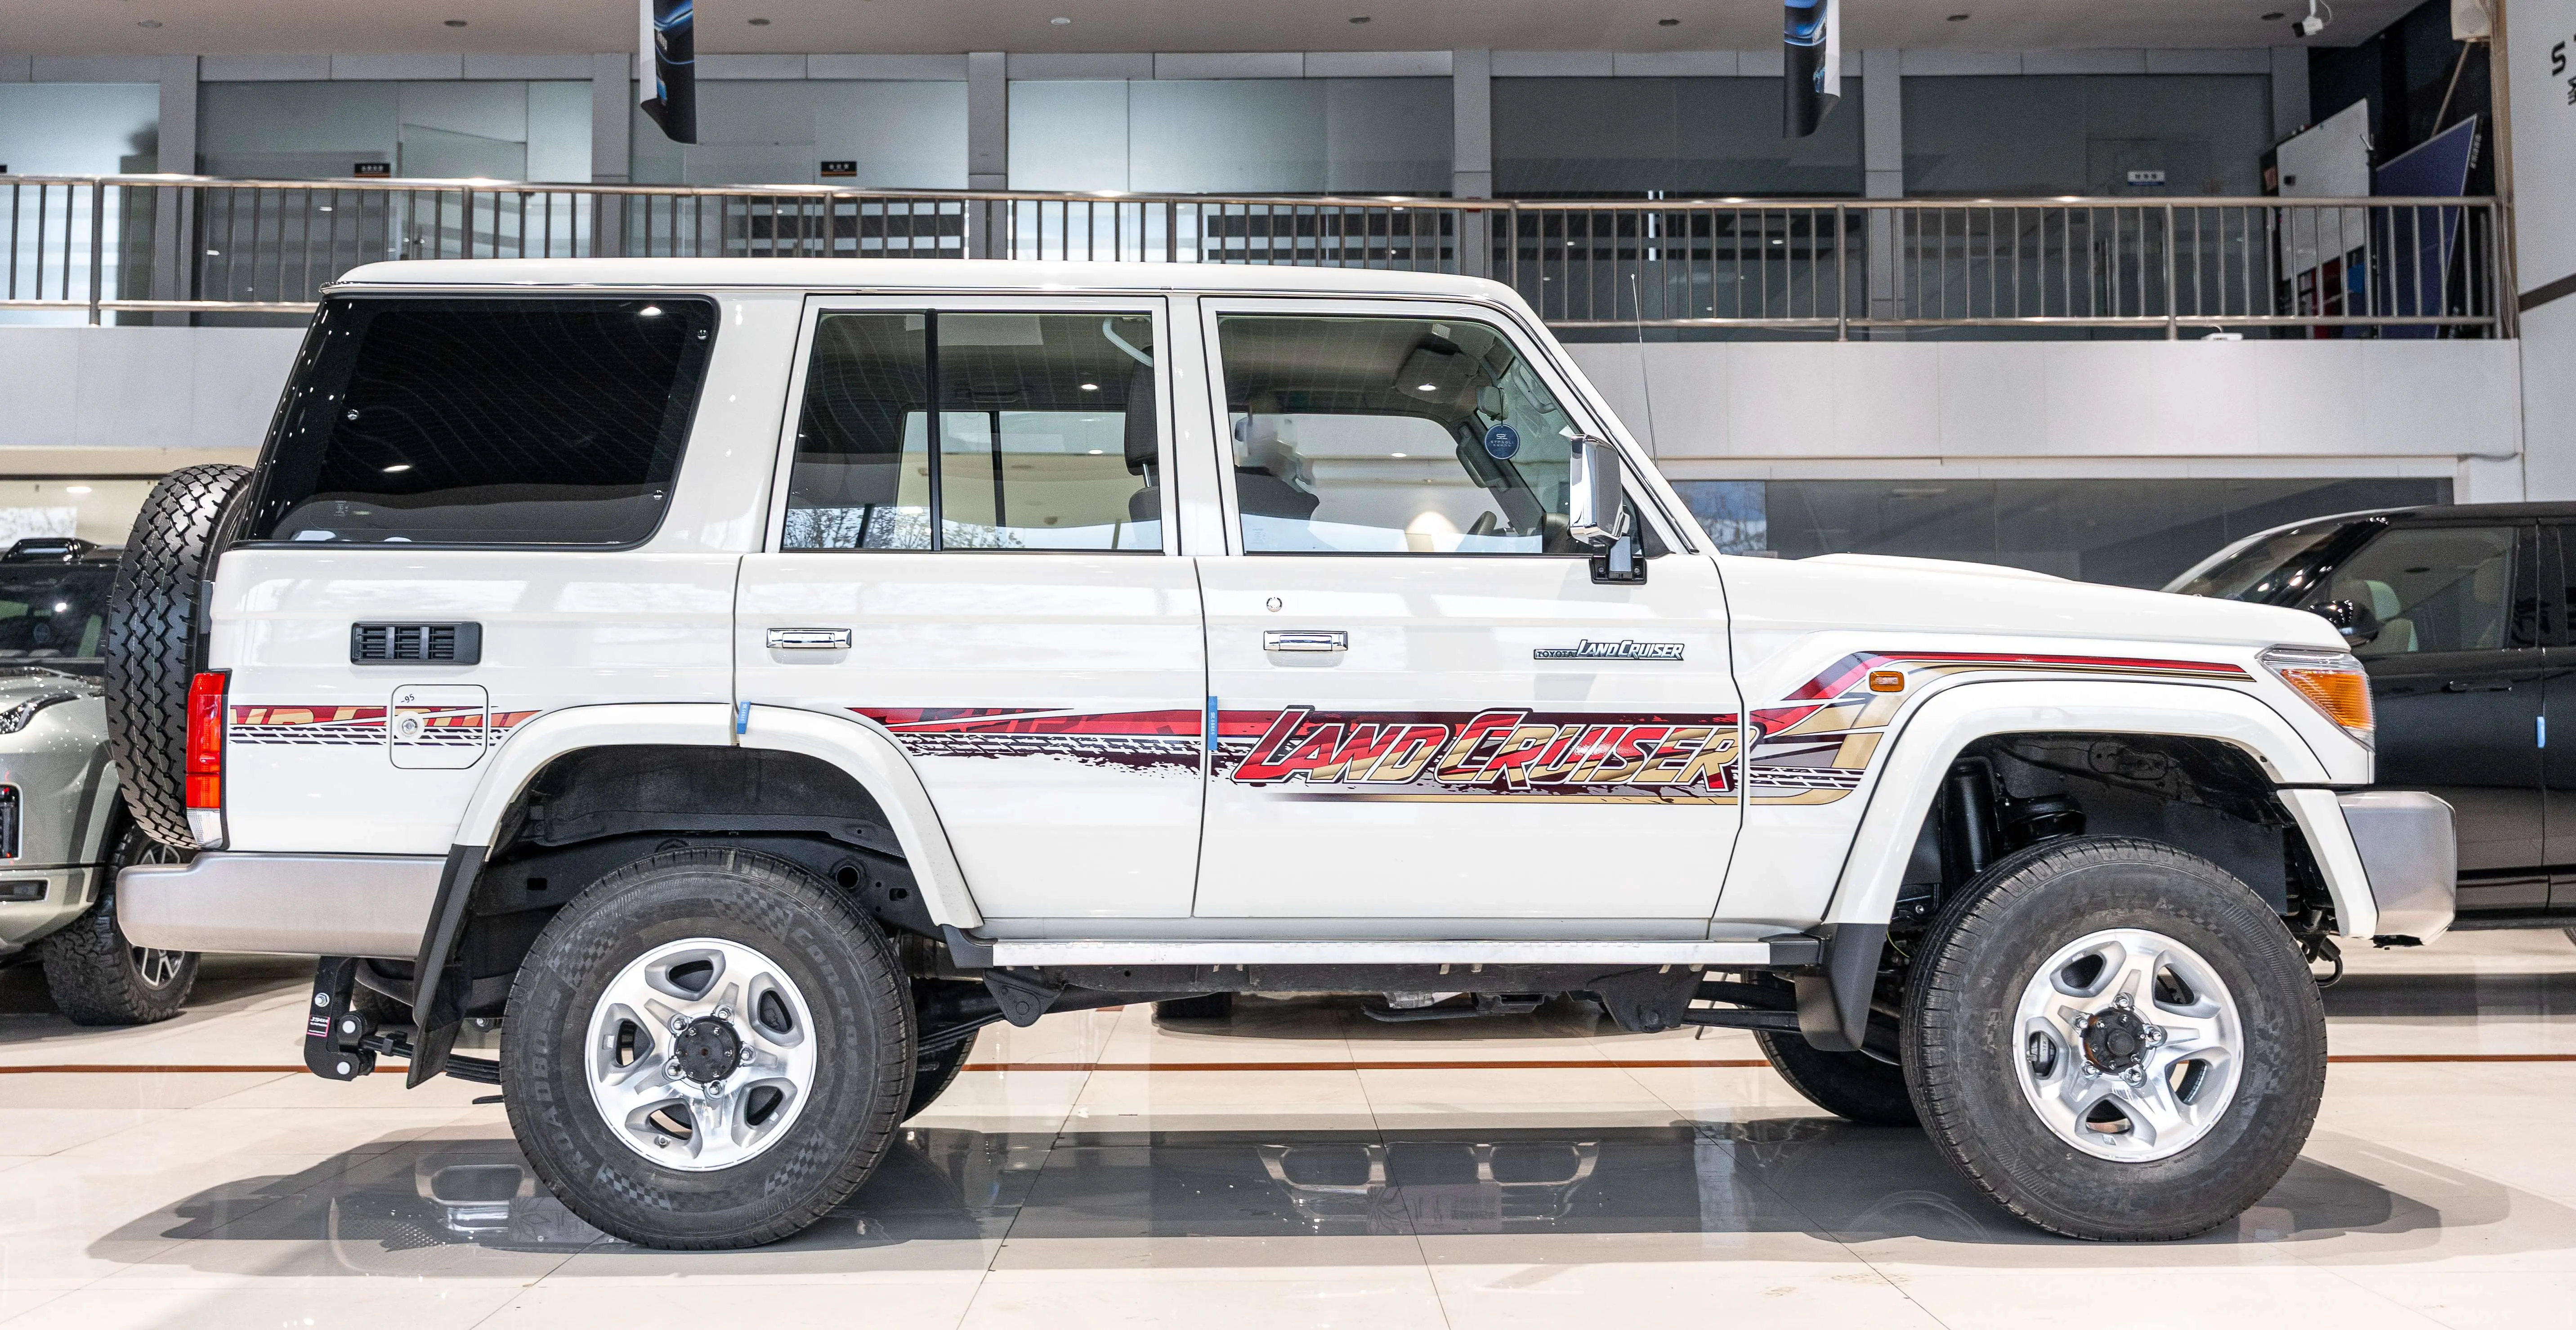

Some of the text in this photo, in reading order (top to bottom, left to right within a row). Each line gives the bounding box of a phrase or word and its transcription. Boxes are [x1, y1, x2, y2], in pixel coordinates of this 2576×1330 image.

[1576, 639, 1620, 658] LAND
[1619, 640, 1684, 659] CRUISER
[1230, 706, 1759, 792] LAND CRUISER
